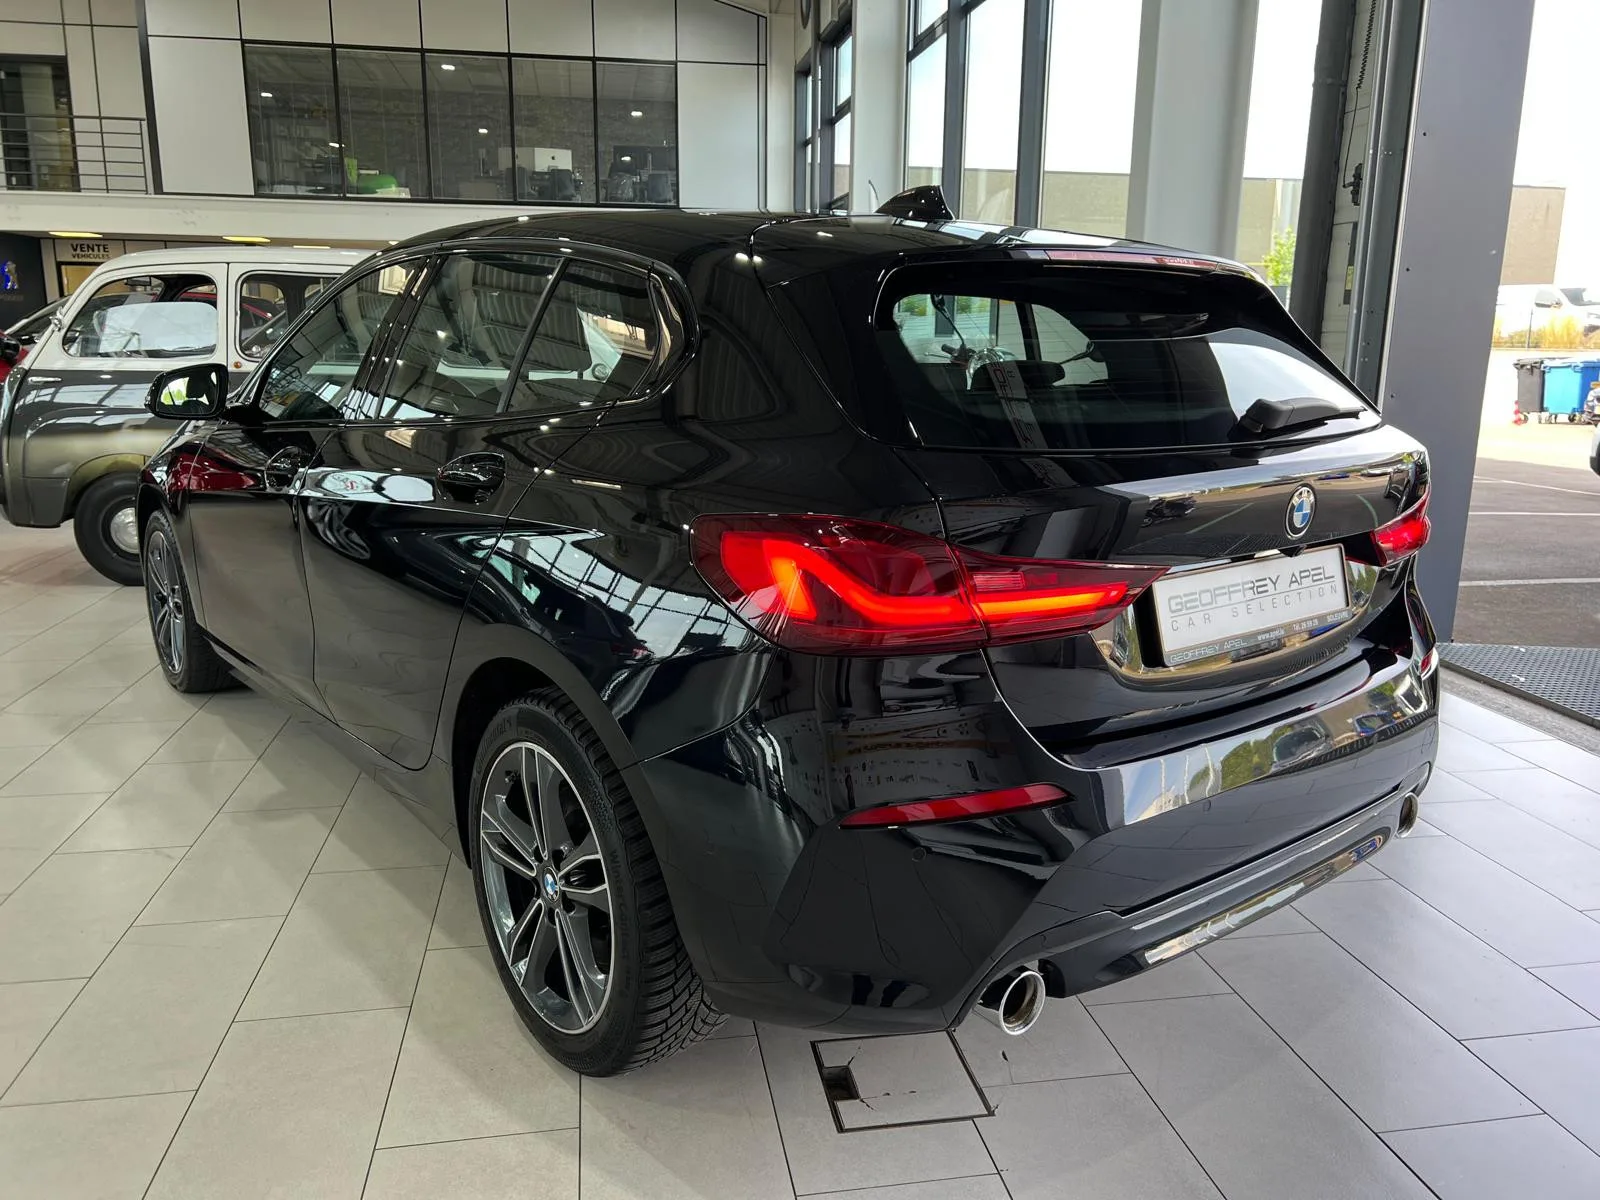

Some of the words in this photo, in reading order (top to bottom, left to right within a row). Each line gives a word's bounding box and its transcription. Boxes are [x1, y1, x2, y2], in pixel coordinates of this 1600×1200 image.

[70, 243, 109, 253] VENTE
[1167, 575, 1281, 614] GEOFFREY
[1288, 566, 1336, 588] APEL
[1171, 613, 1212, 632] CAR
[1232, 584, 1337, 618] SELECTION
[1170, 644, 1221, 663] GEOFFREY
[1223, 639, 1248, 650] APEL
